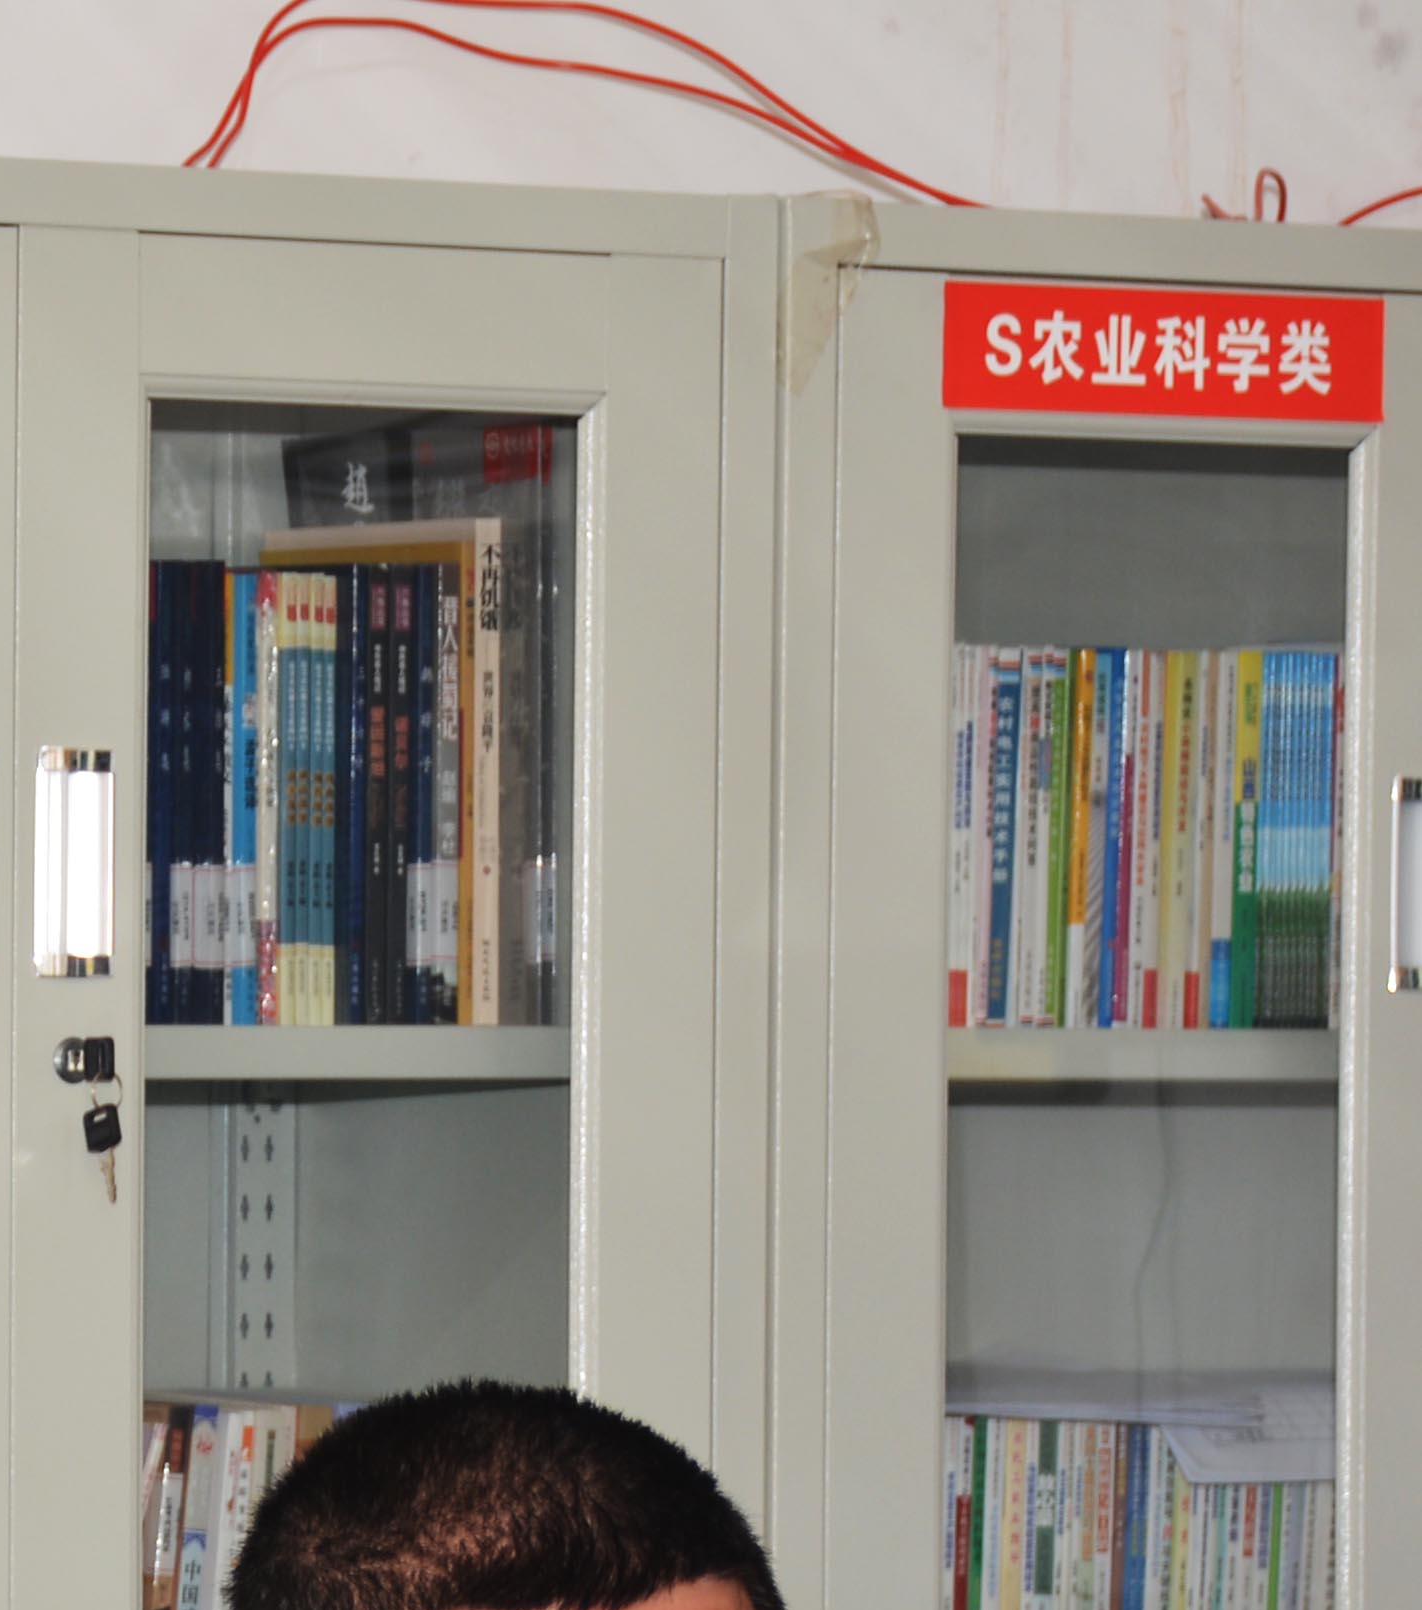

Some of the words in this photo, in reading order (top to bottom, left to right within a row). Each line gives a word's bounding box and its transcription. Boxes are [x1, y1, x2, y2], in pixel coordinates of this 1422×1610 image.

[985, 310, 1332, 395] S农业科学类
[481, 544, 501, 631] 不再饥饿
